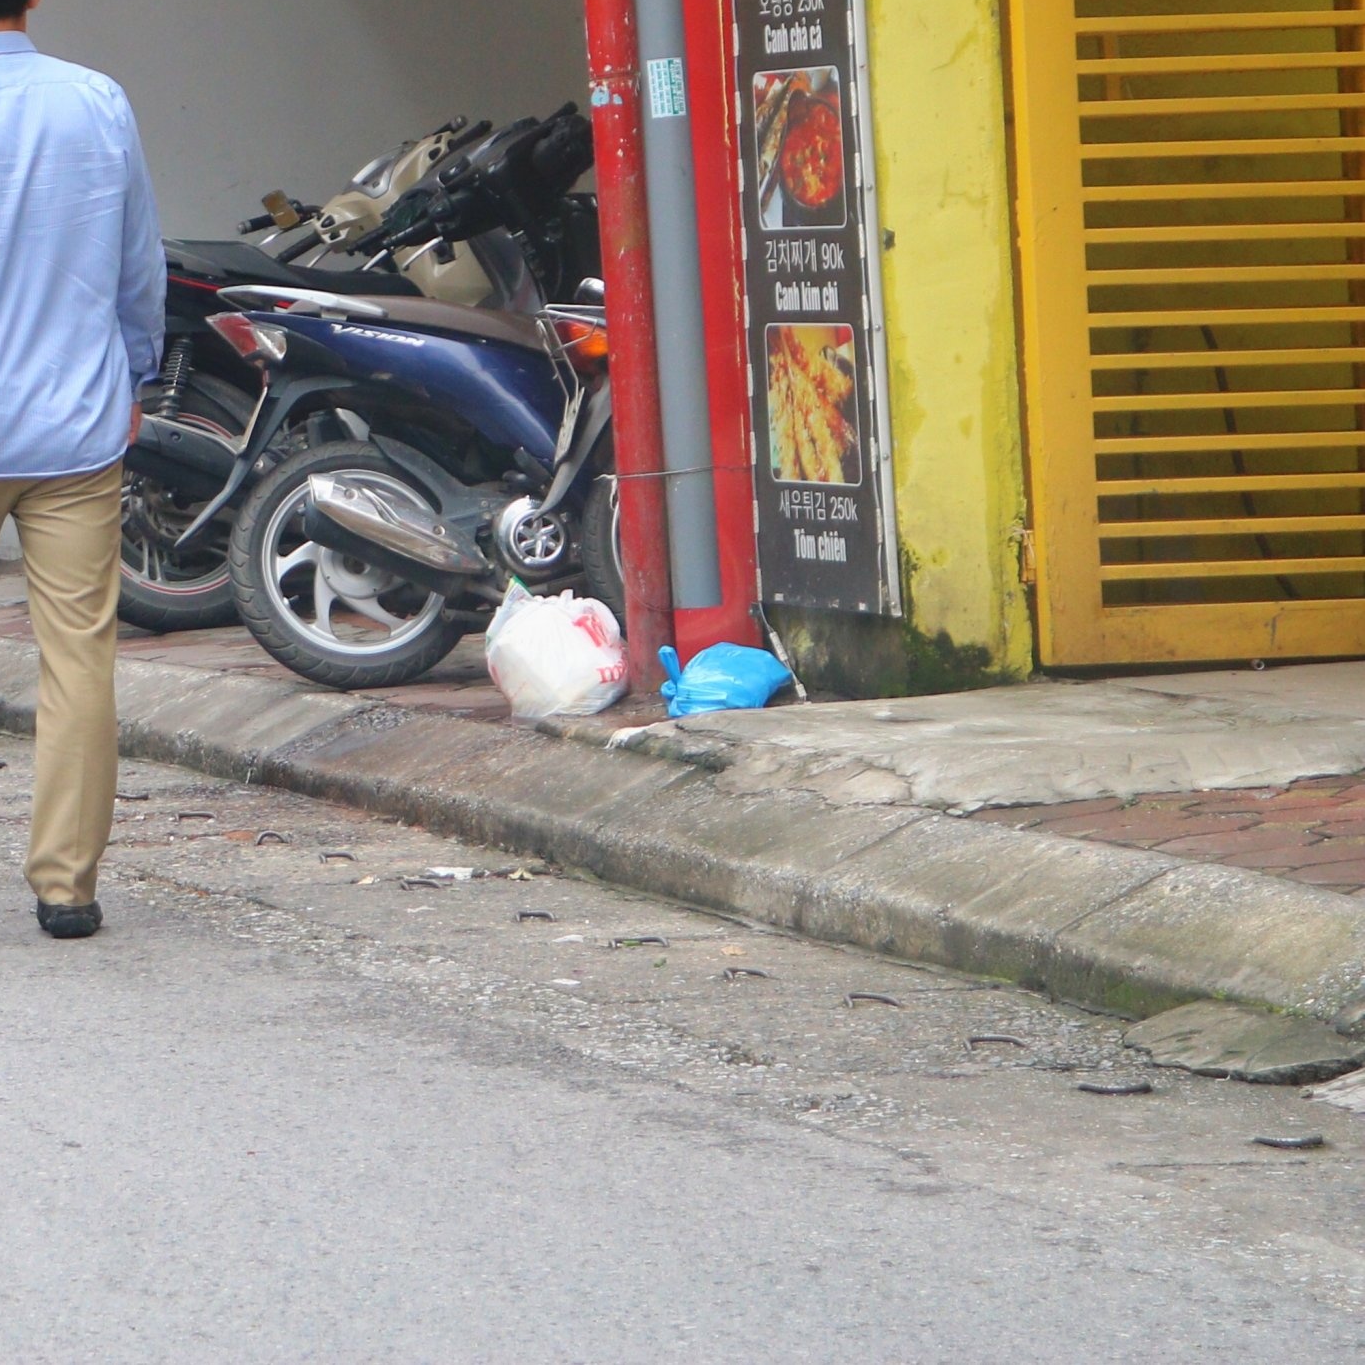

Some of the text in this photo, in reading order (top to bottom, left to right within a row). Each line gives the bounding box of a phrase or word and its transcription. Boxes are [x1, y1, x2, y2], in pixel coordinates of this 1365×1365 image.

[764, 17, 823, 56] Canh chả cá
[765, 238, 845, 275] 김치찌개 90k
[775, 281, 839, 313] Canh kim chi
[331, 323, 426, 347] VISION
[830, 496, 859, 522] 250k
[794, 527, 847, 563] Tôm chiên
